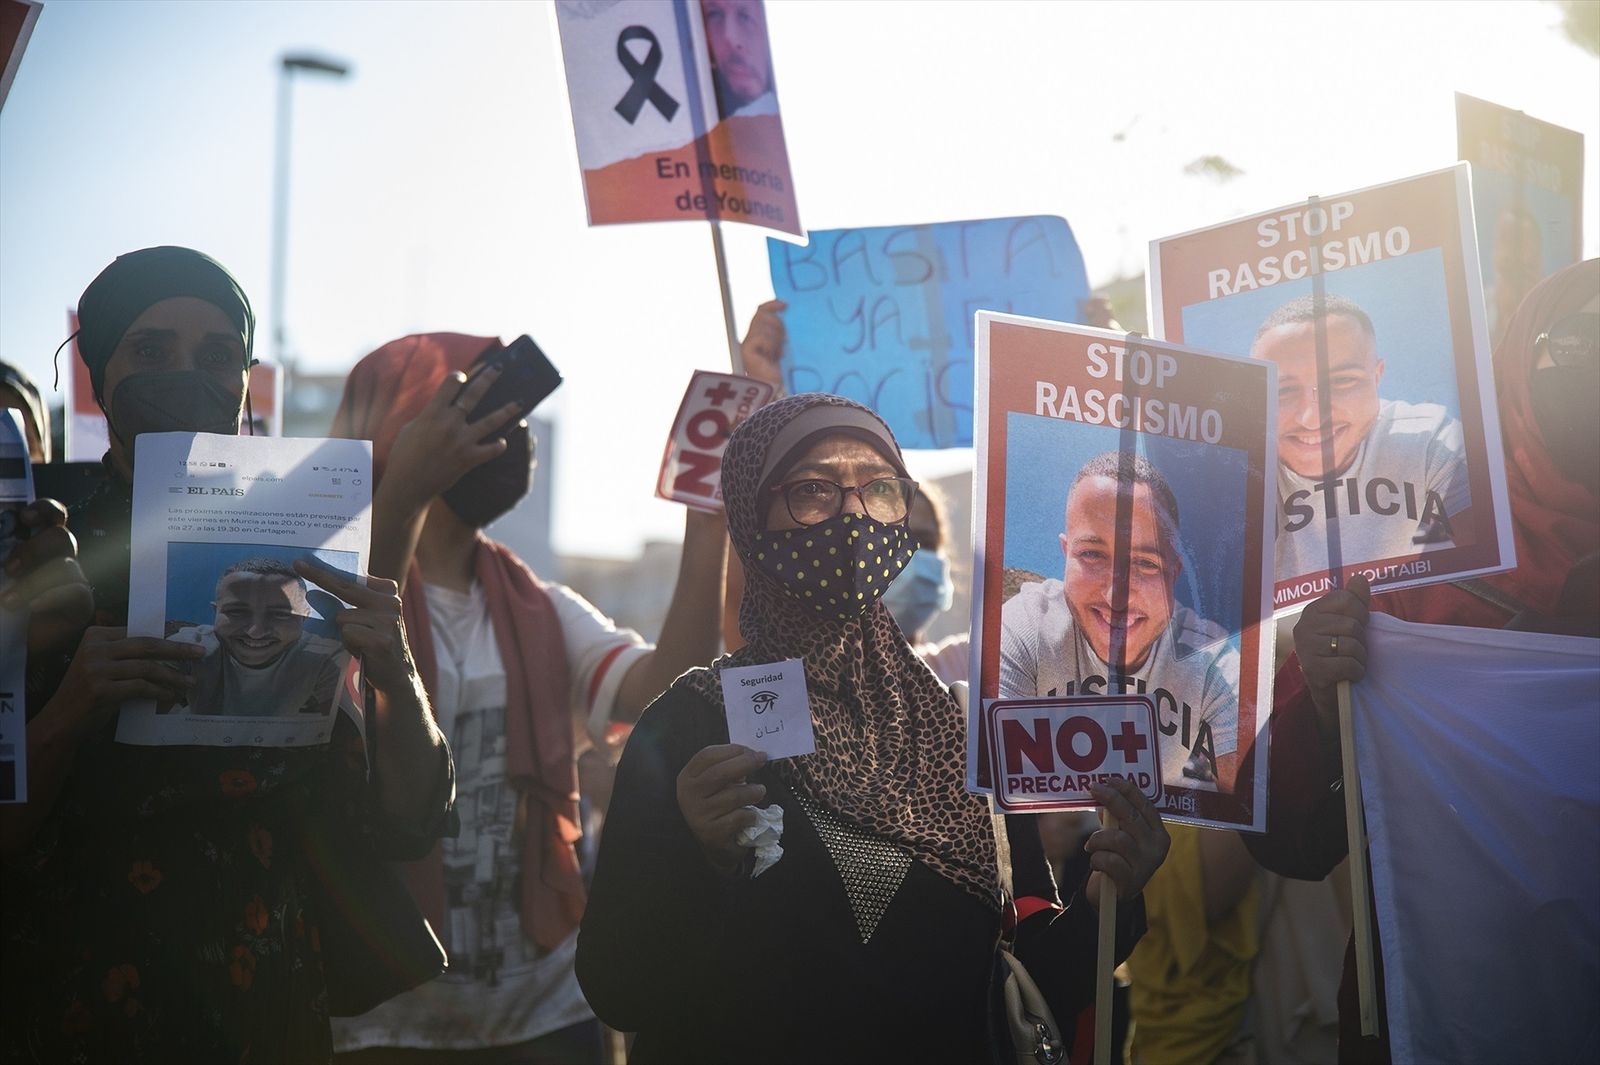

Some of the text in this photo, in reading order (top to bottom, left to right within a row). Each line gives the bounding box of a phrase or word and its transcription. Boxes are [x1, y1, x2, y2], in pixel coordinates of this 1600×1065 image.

[656, 157, 785, 191] En memoria
[675, 189, 785, 223] de Younes
[1256, 201, 1354, 248] STOP
[783, 217, 1062, 292] BASTA
[1207, 225, 1411, 300] RASCISMO
[826, 294, 905, 354] YA
[1086, 342, 1178, 389] STOP
[1035, 380, 1223, 445] RASCISMO
[186, 486, 245, 497] EL PAÍS
[184, 507, 223, 516] próximas
[224, 509, 285, 517] movilizaciones
[285, 511, 309, 519] están
[309, 513, 346, 521] previstas
[187, 516, 218, 524] viernes
[307, 521, 313, 529] y
[1275, 477, 1457, 546] STICIA
[1352, 559, 1431, 582] OUTAIBI
[740, 672, 783, 687] Seguridad
[755, 719, 785, 739] أمان
[1001, 715, 1148, 775] NO+
[1165, 794, 1195, 813] AIBI
